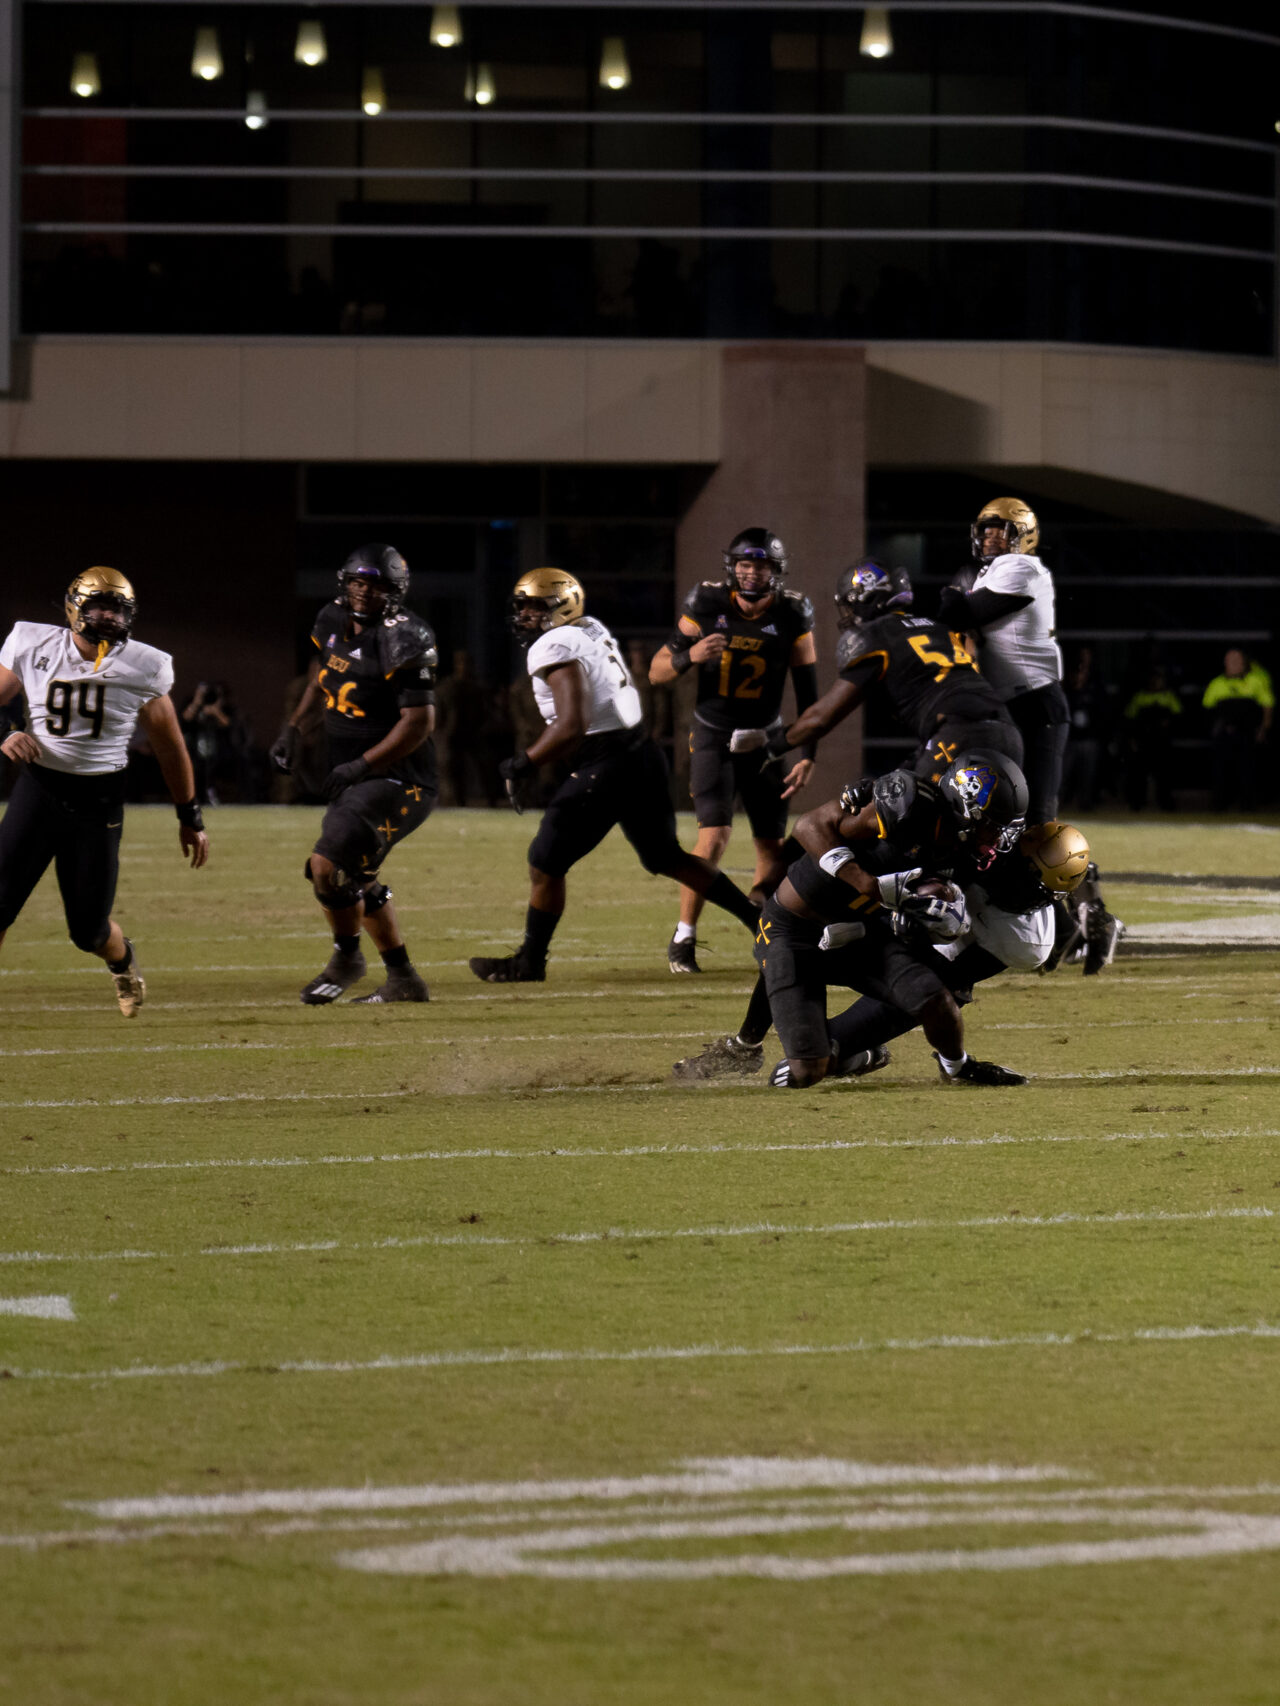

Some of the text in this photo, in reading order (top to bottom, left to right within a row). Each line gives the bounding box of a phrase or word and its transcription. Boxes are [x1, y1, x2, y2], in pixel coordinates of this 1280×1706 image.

[717, 650, 768, 700] 12
[907, 631, 980, 684] 54
[46, 679, 106, 739] 94
